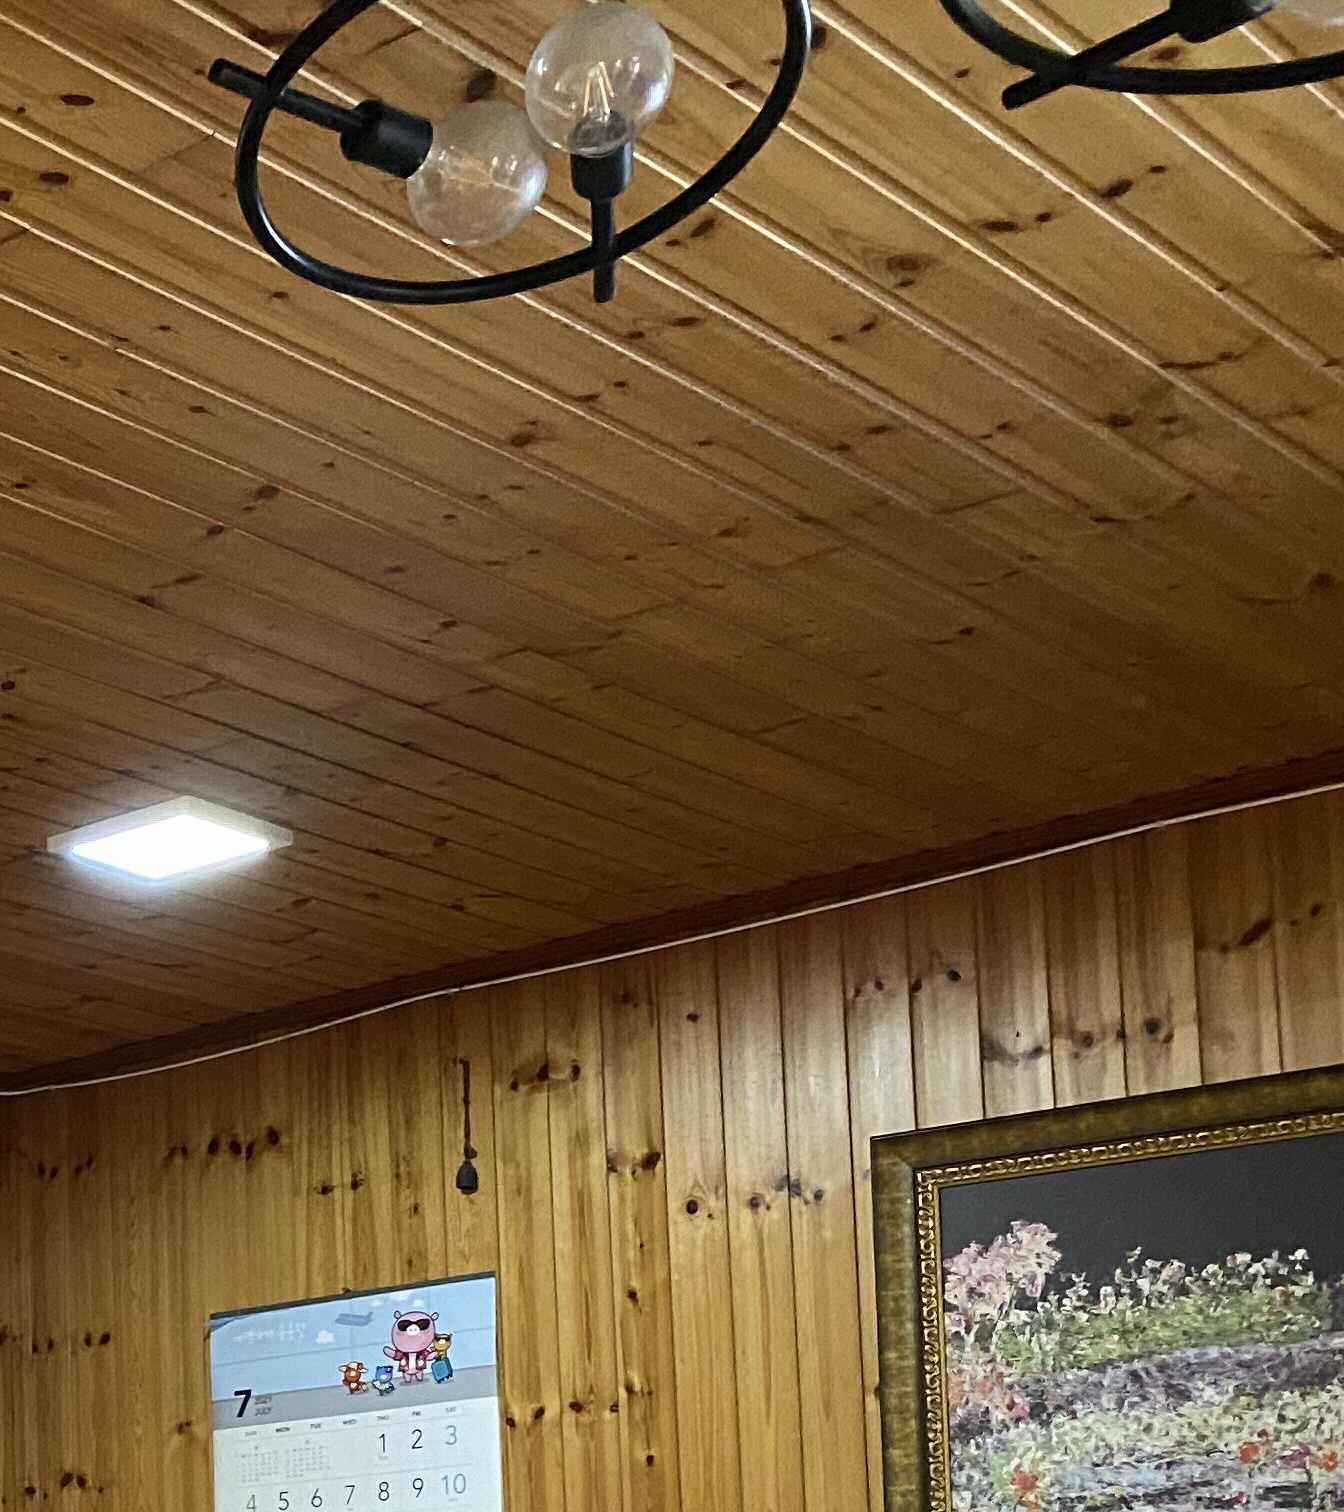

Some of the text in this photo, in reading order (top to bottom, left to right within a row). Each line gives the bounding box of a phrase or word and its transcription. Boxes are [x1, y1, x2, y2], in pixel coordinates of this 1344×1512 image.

[234, 1389, 251, 1418] 7
[379, 1425, 457, 1453] 1 2 3
[246, 1474, 466, 1512] 4 5 6 7 8 9 10
